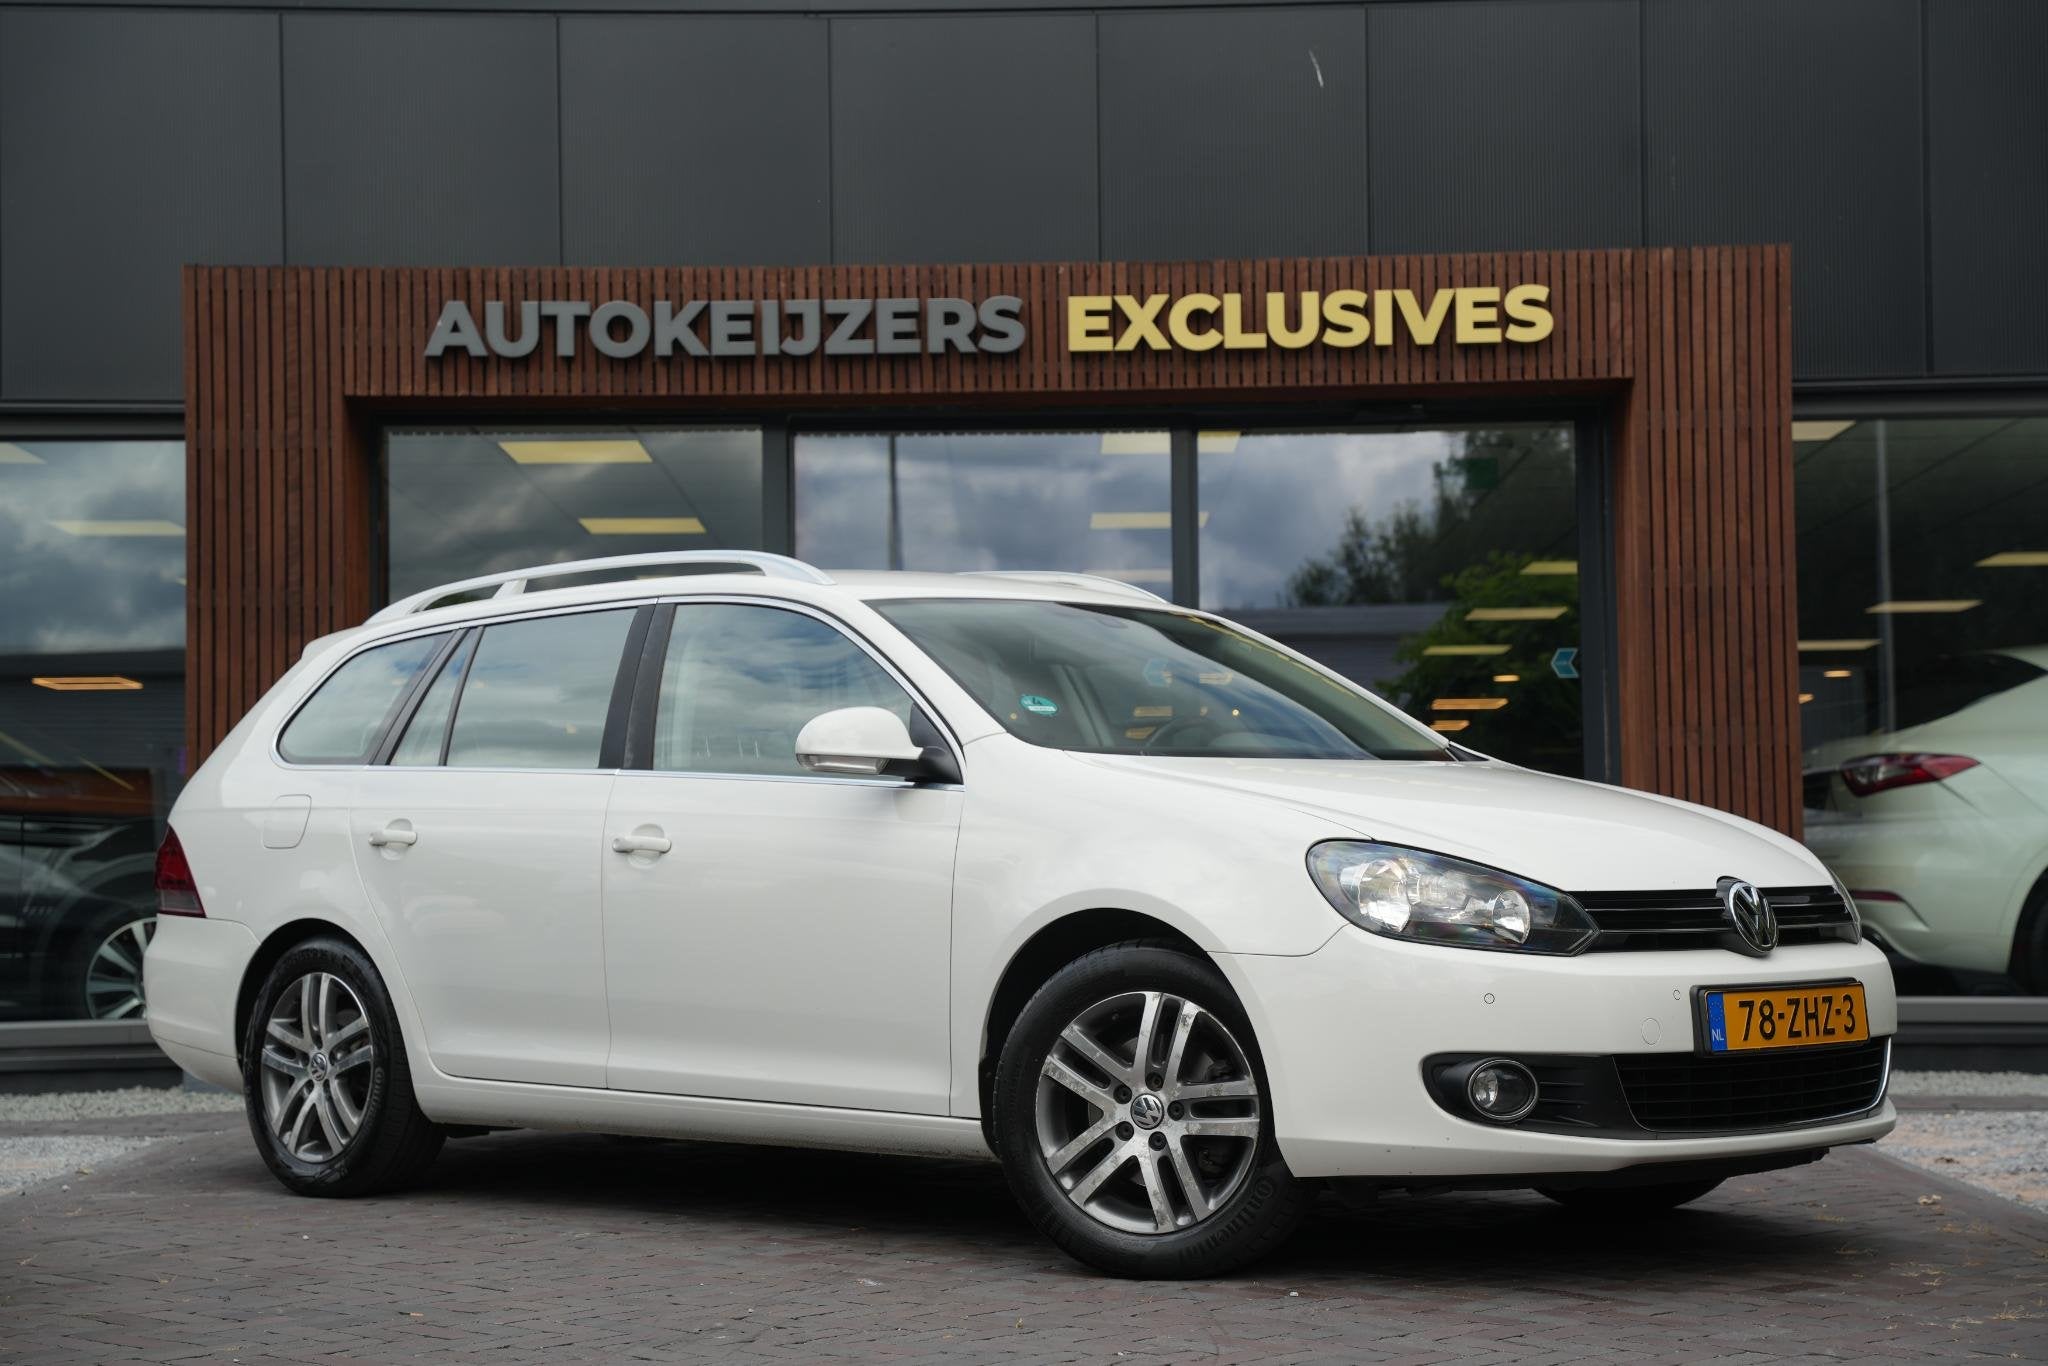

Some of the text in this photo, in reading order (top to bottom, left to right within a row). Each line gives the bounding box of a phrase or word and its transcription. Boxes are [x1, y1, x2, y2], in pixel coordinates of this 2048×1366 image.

[424, 284, 1554, 358] AUTOKEIJZERS EXCLUSIVES
[1711, 1028, 1725, 1041] NL
[1738, 994, 1856, 1041] 78-ZHZ-3
